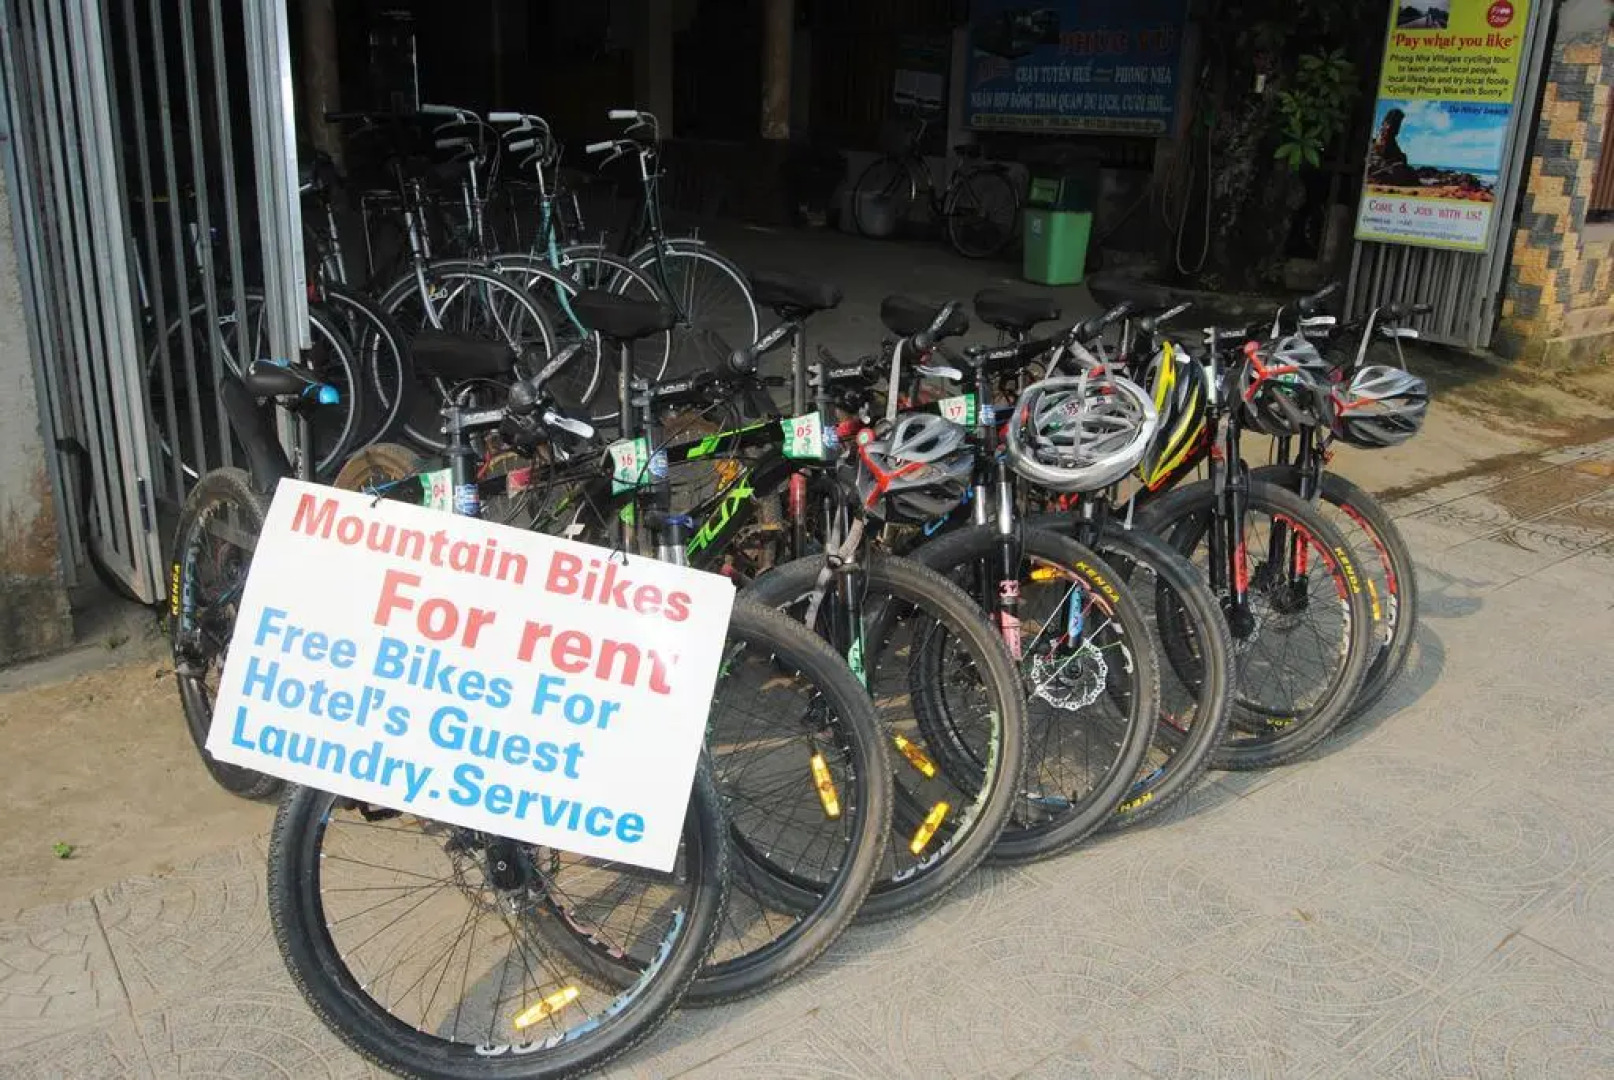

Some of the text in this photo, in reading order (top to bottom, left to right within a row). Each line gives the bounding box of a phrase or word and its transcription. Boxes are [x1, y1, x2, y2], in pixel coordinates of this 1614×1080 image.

[1423, 34, 1455, 49] what
[1459, 37, 1482, 50] you
[1390, 53, 1413, 63] Phong
[1415, 54, 1430, 62] Nha
[1432, 54, 1461, 64] Villages
[1463, 55, 1491, 64] cycling
[1407, 65, 1425, 73] learn
[1450, 66, 1469, 74] local
[1388, 75, 1406, 83] local
[1407, 75, 1435, 85] lifestyle
[1417, 86, 1441, 95] Phong
[1442, 86, 1458, 94] Nha
[1460, 87, 1477, 95] with
[1399, 202, 1407, 213] &
[796, 424, 812, 439] 05
[291, 493, 691, 622] Mountain Bikes
[172, 562, 181, 616] KENDA
[1075, 561, 1120, 603] KENDA
[373, 570, 680, 695] For rent
[253, 606, 621, 730] Free Bikes For
[241, 656, 584, 780] Hotel's Guest
[1116, 792, 1154, 814] KEN
